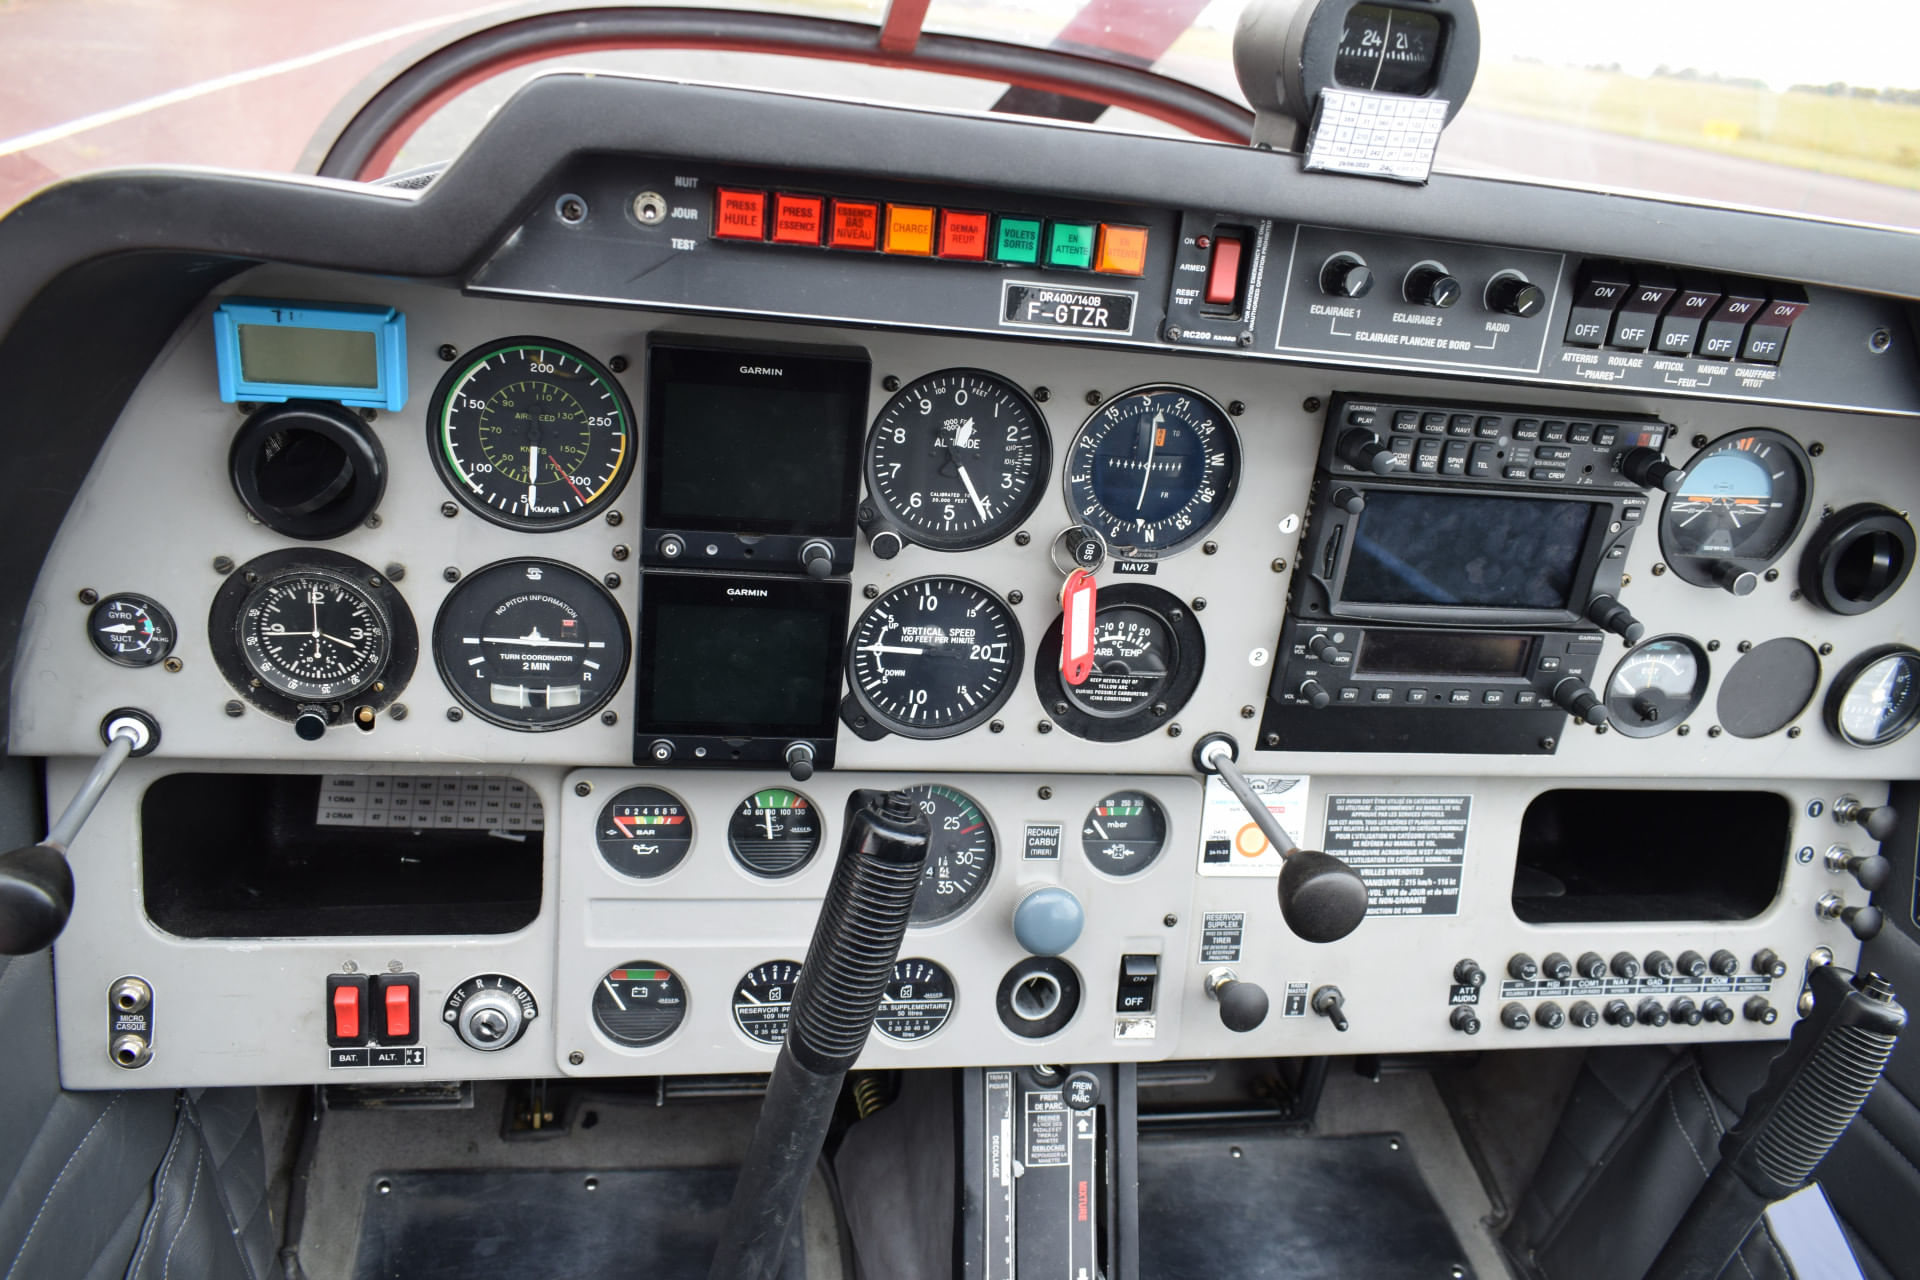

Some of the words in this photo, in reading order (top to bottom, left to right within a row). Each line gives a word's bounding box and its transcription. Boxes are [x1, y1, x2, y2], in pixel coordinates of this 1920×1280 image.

[1362, 30, 1382, 47] 24
[674, 176, 698, 188] NUIT
[671, 208, 698, 220] JOUR
[724, 213, 757, 226] HUILE
[780, 220, 816, 232] ESSENCE
[893, 222, 929, 234] CHARGE
[836, 228, 872, 240] NIVEAU
[1004, 228, 1036, 240] VOLETS
[1068, 234, 1079, 243] EN
[672, 238, 695, 250] TEST
[1003, 239, 1034, 251] SORTIS
[1056, 246, 1089, 256] ATTENTE
[1180, 264, 1206, 272] ARMED
[1039, 290, 1102, 306] DR400/140B
[1176, 288, 1200, 297] RESET
[1594, 288, 1616, 298] ON
[1642, 291, 1662, 302] ON
[1175, 297, 1193, 305] TEST
[1686, 296, 1706, 308] ON
[1310, 304, 1354, 318] ECLAIRAGE
[1356, 308, 1362, 318] 1
[1729, 302, 1749, 314] ON
[1774, 306, 1796, 316] ON
[1027, 302, 1108, 328] F-GTZR
[1392, 312, 1435, 326] ECLAIRAGE
[1436, 316, 1443, 326] 2
[1486, 322, 1510, 333] RADIO
[1575, 324, 1600, 336] OFF
[1184, 330, 1211, 340] RC200
[1621, 328, 1646, 341] OFF
[1666, 334, 1690, 346] OFF
[1355, 331, 1398, 345] ECLAIRAGE
[1400, 335, 1436, 348] PLANCHE
[1436, 338, 1448, 349] DE
[1449, 339, 1471, 351] BORD
[1708, 338, 1732, 352] OFF
[1752, 342, 1776, 354] OFF
[1562, 352, 1598, 364] ATTERRIS
[1608, 356, 1643, 368] ROULAGE
[530, 364, 554, 374] 200
[740, 366, 783, 376] GARMIN
[1654, 360, 1684, 372] ANTICOL
[1698, 366, 1728, 376] NAVIGAT
[1584, 370, 1615, 381] PHARES
[1735, 368, 1776, 380] CHAUFFAGE
[1678, 377, 1697, 388] FEUX
[1742, 378, 1764, 388] PITOT
[955, 390, 968, 406] 0
[463, 400, 486, 410] 150
[920, 400, 932, 415] 9
[1175, 398, 1190, 412] 21
[1104, 406, 1120, 420] 15
[588, 416, 612, 427] 250
[1201, 420, 1216, 434] 24
[894, 428, 906, 444] 8
[1007, 426, 1018, 442] 2
[1080, 436, 1094, 450] 12
[1212, 452, 1224, 466] W
[471, 464, 492, 474] 100
[890, 463, 901, 478] 7
[1001, 474, 1012, 488] 3
[1072, 473, 1085, 482] E
[910, 492, 922, 508] 6
[532, 506, 560, 514] KM/HR
[944, 505, 956, 520] 5
[1145, 530, 1154, 542] N
[1084, 544, 1096, 560] OBS
[1122, 563, 1150, 572] NAV2
[307, 592, 325, 604] 12
[726, 588, 768, 598] GARMIN
[495, 605, 507, 616] NO
[506, 595, 528, 608] PITCH
[530, 594, 578, 618] INFORMATION
[919, 596, 938, 612] 10
[108, 612, 132, 620] GYRO
[966, 608, 976, 618] 15
[350, 628, 364, 640] 3
[902, 626, 944, 637] VERTICAL
[950, 628, 976, 638] SPEED
[1128, 624, 1138, 632] 10
[1139, 628, 1150, 636] 20
[522, 654, 573, 662] COORDINATOR
[970, 645, 991, 660] 20
[1120, 648, 1142, 657] TEMP
[522, 662, 530, 670] 2
[531, 662, 550, 671] MIN
[476, 670, 484, 678] L
[584, 672, 592, 681] R
[957, 686, 967, 694] 15
[909, 690, 928, 704] 10
[944, 816, 960, 830] 25
[1107, 820, 1128, 828] mbar
[1026, 828, 1060, 837] RECHAUF
[1029, 838, 1057, 848] CARBU
[956, 852, 974, 865] 30
[1030, 848, 1053, 857] (TIRER)
[936, 881, 954, 894] 35
[476, 978, 484, 990] R
[497, 978, 503, 988] L
[450, 990, 466, 1008] OFF
[512, 986, 534, 1010] BOTH
[1124, 996, 1144, 1006] OFF
[1452, 994, 1477, 1002] AUDIO
[116, 1022, 147, 1031] CASQUE
[1072, 1082, 1092, 1090] FREIN
[1072, 1095, 1090, 1103] PARC
[1044, 1102, 1064, 1110] PARC
[1078, 1180, 1088, 1222] MIXTURE
